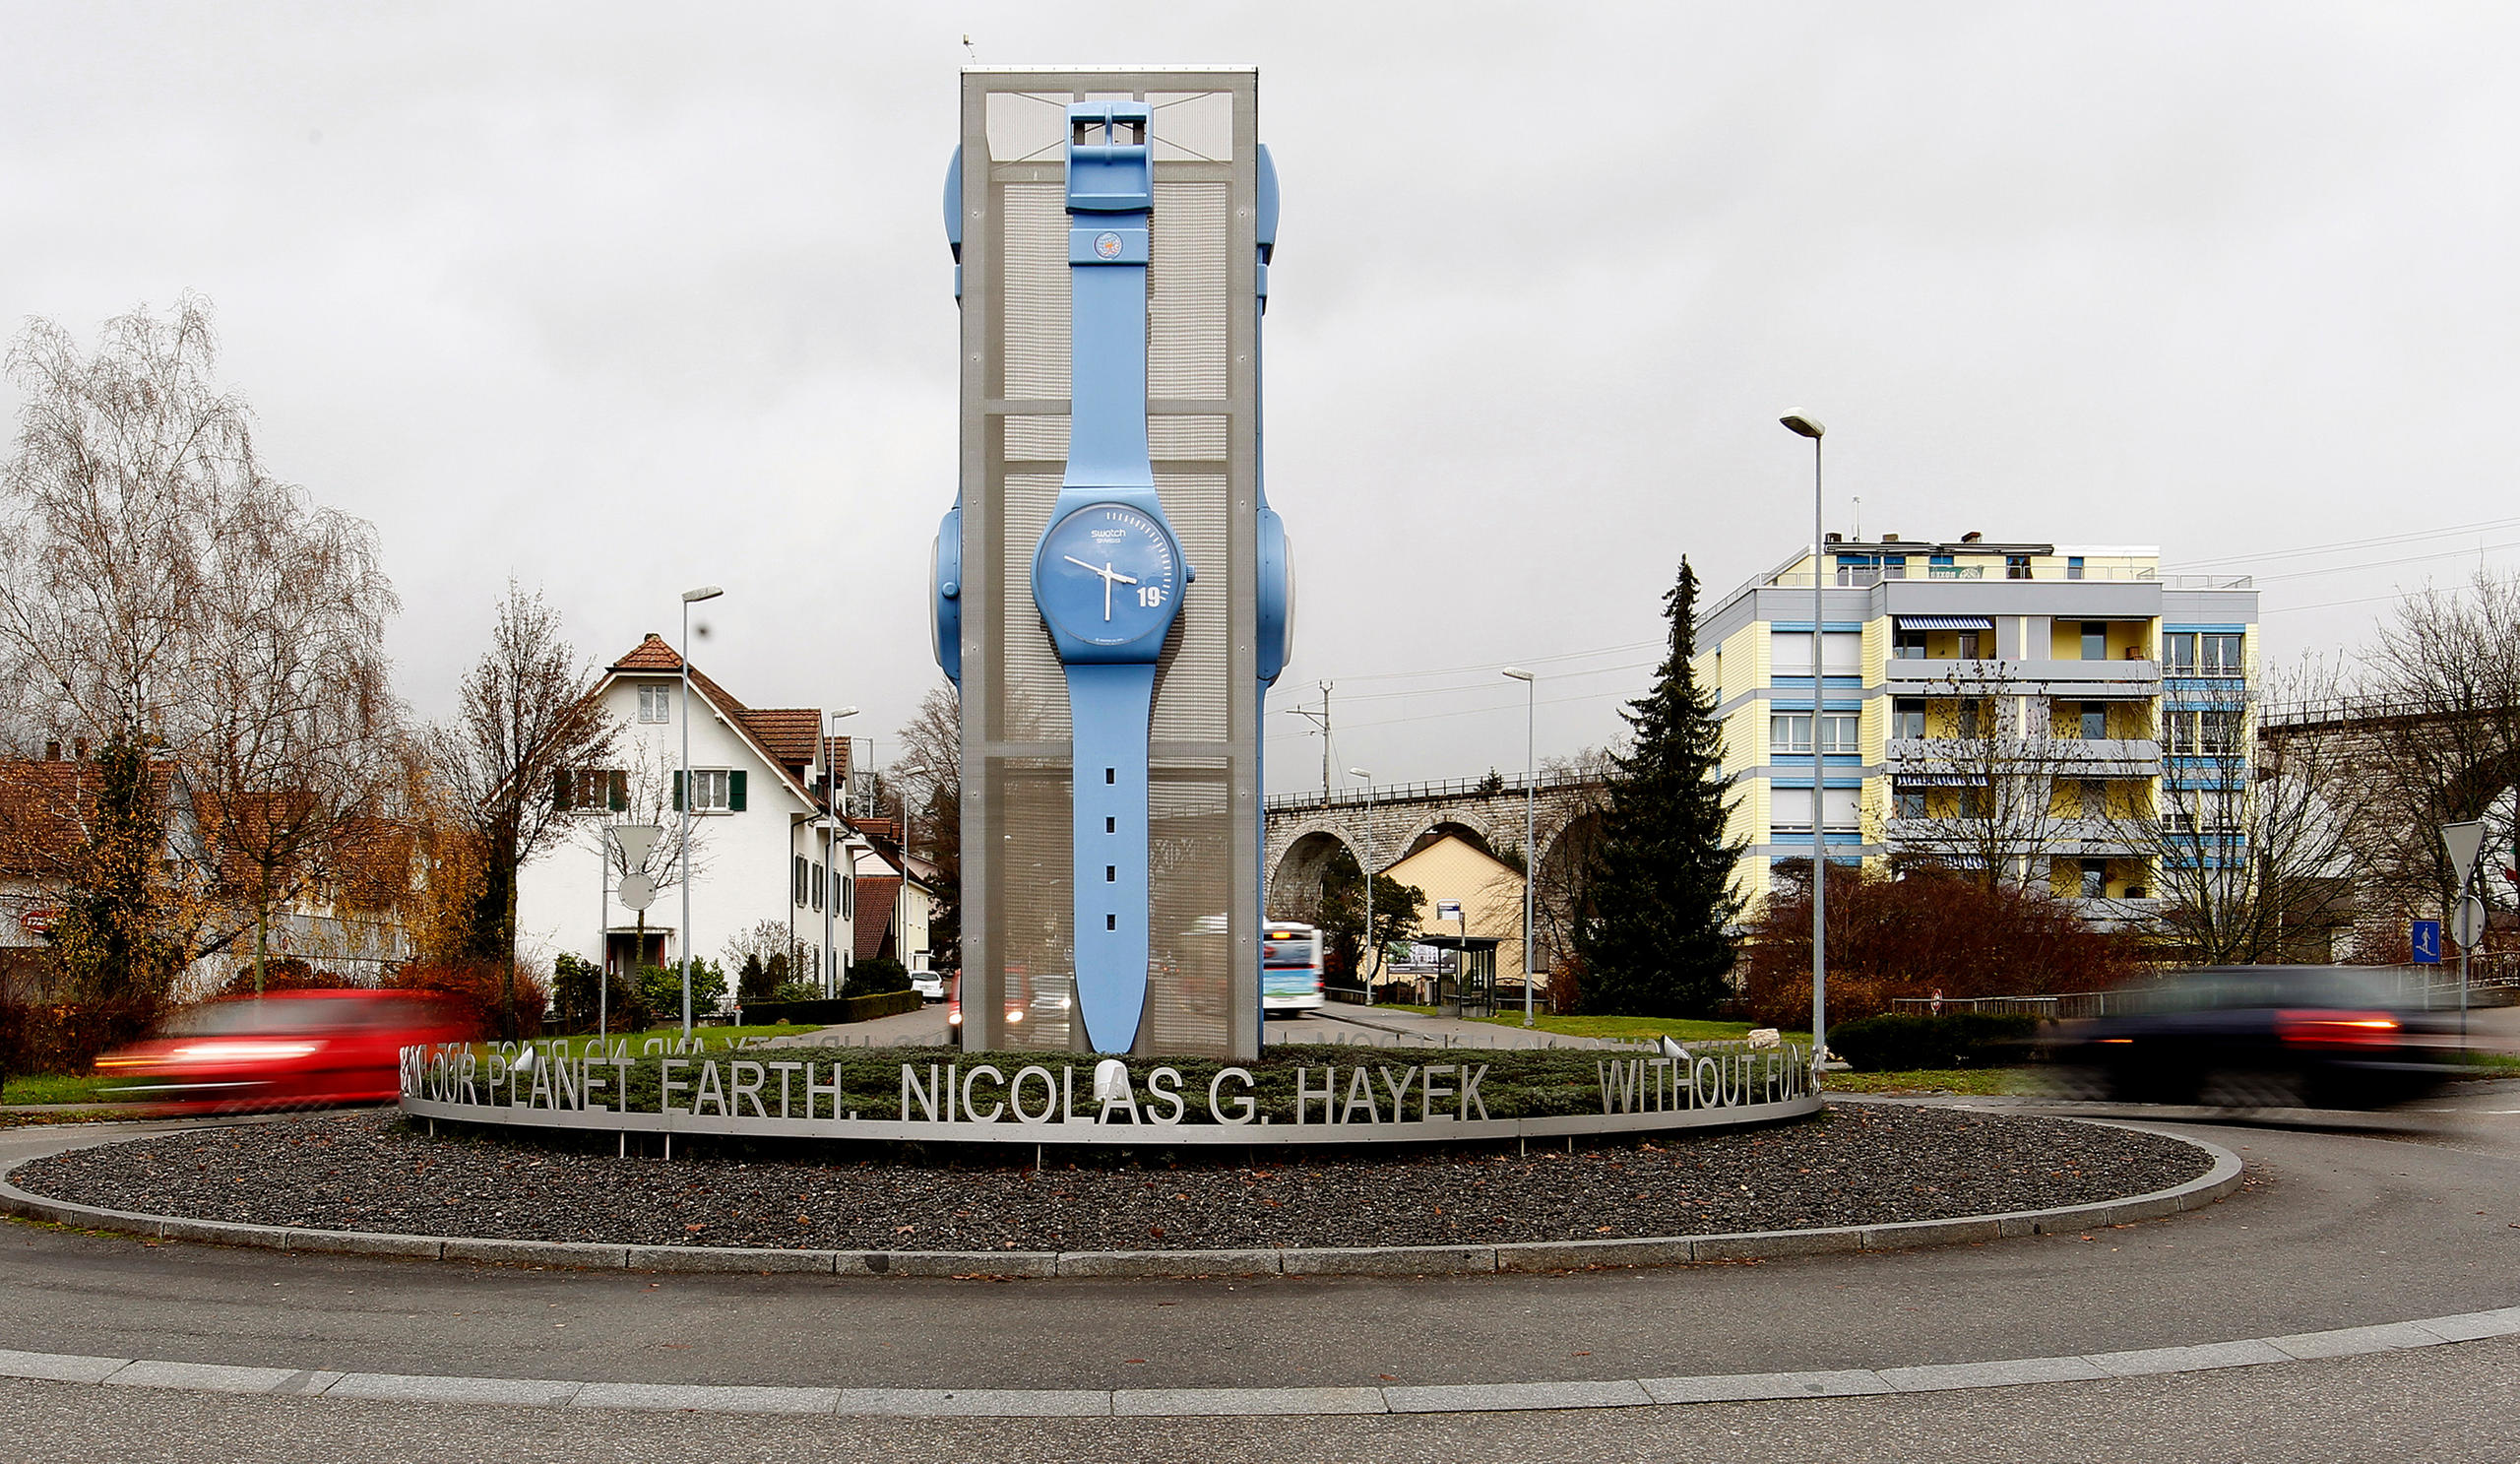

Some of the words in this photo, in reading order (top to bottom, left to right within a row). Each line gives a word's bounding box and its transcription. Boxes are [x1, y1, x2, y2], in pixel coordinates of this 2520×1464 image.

[1091, 528, 1126, 538] swatch
[1137, 586, 1161, 607] 19
[431, 1051, 477, 1106] OUR
[488, 1054, 635, 1114] PLANET
[662, 1059, 857, 1121] EARTH.
[901, 1063, 1185, 1125] NICOLAS
[1208, 1067, 1269, 1125] G.
[1297, 1064, 1490, 1125] HAYEK
[1597, 1055, 1756, 1114] WITHOUT
